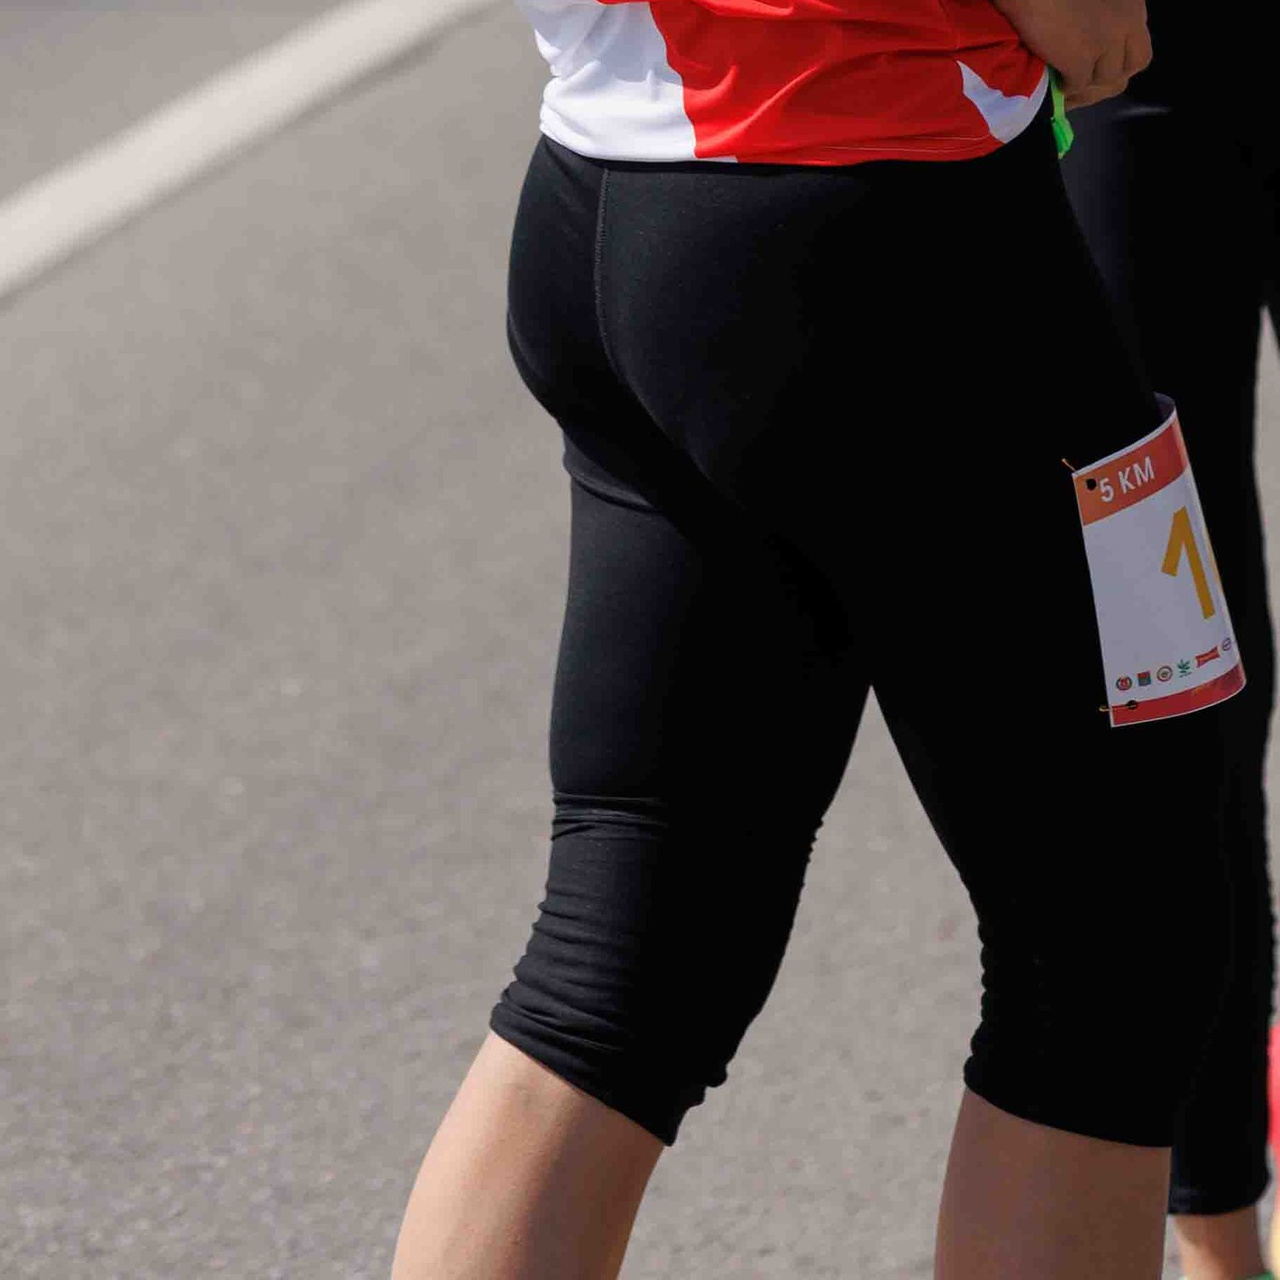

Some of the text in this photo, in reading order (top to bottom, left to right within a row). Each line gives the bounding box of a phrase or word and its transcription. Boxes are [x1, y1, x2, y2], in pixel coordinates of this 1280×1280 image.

[1100, 455, 1155, 503] 5 KM
[1161, 505, 1216, 620] 1
